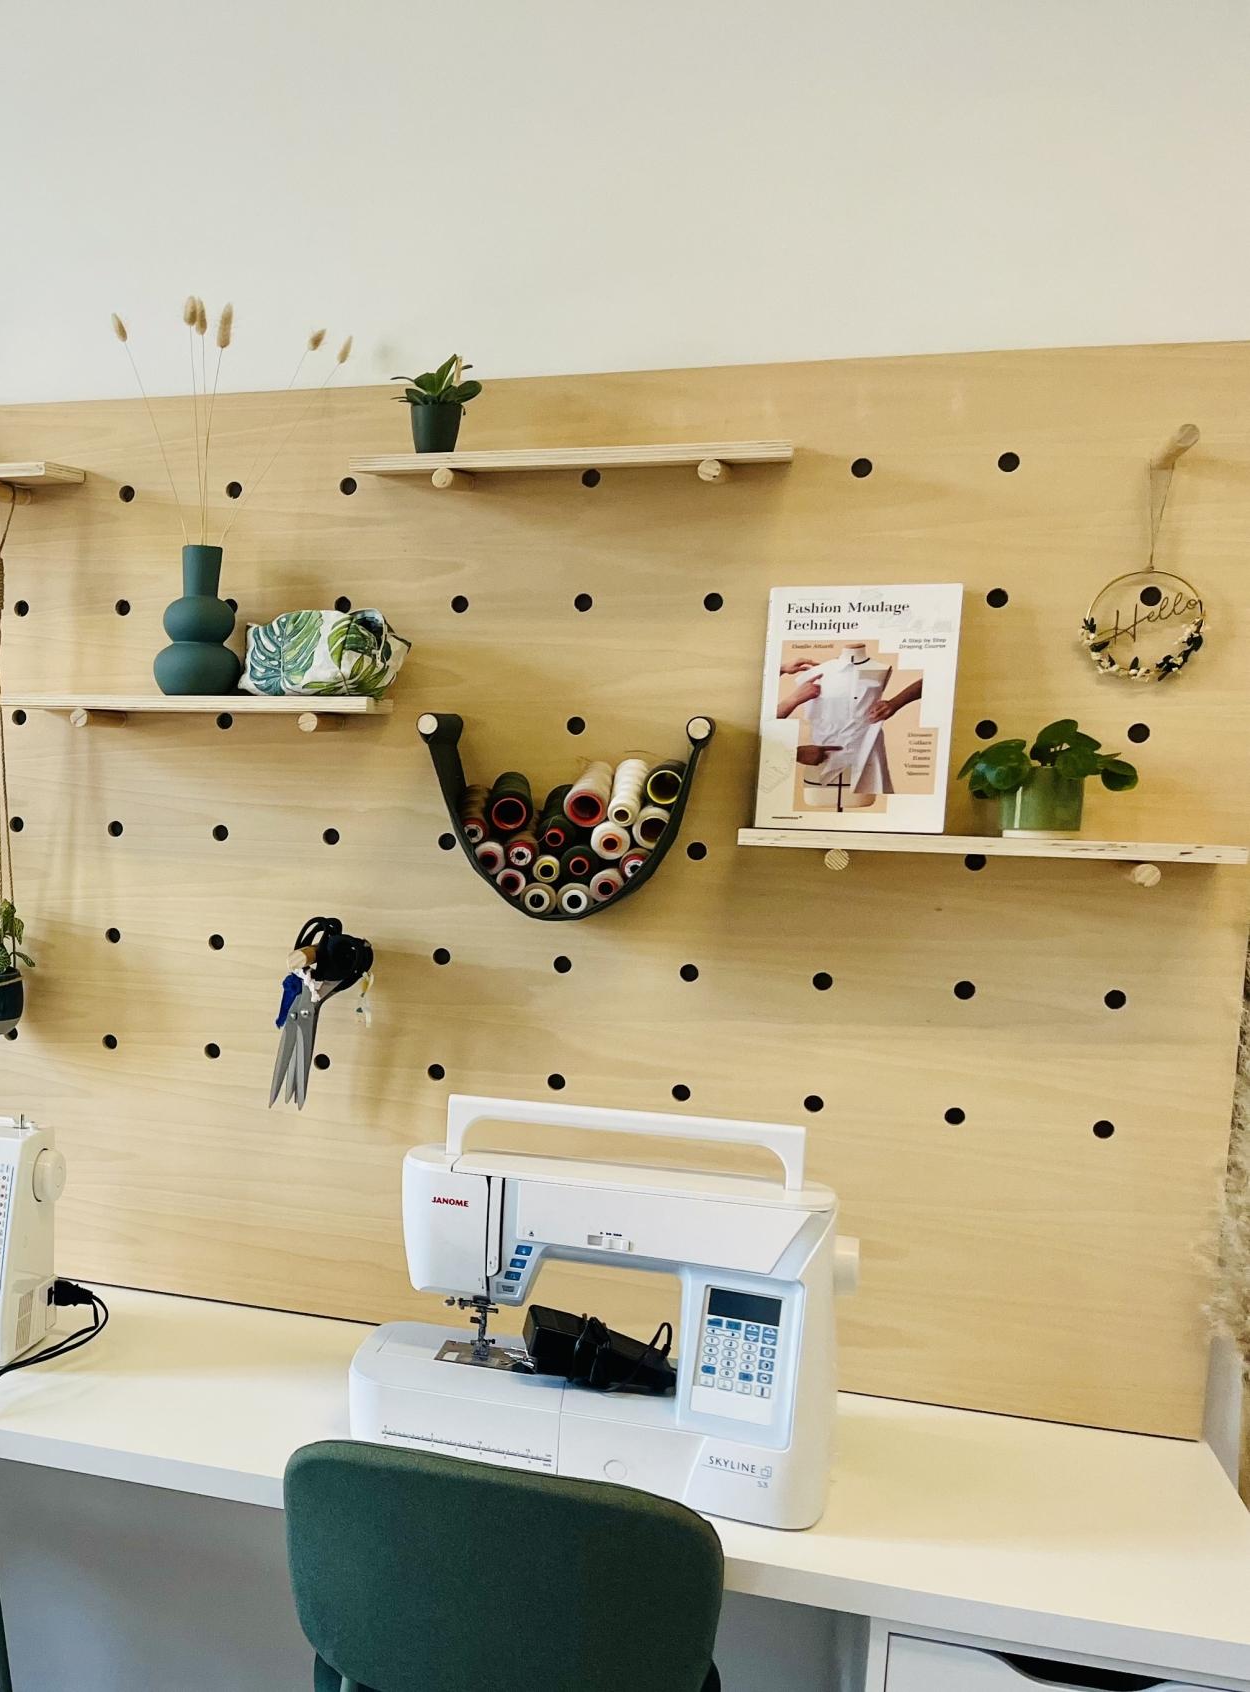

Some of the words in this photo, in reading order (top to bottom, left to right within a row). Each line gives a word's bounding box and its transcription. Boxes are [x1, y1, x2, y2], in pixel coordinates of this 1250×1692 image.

[787, 602, 842, 614] Fashion
[848, 601, 910, 616] Moulage
[786, 619, 859, 633] Technique
[1097, 592, 1202, 645] Hello
[431, 1197, 470, 1208] JANOME
[709, 1455, 756, 1474] SKYLINE
